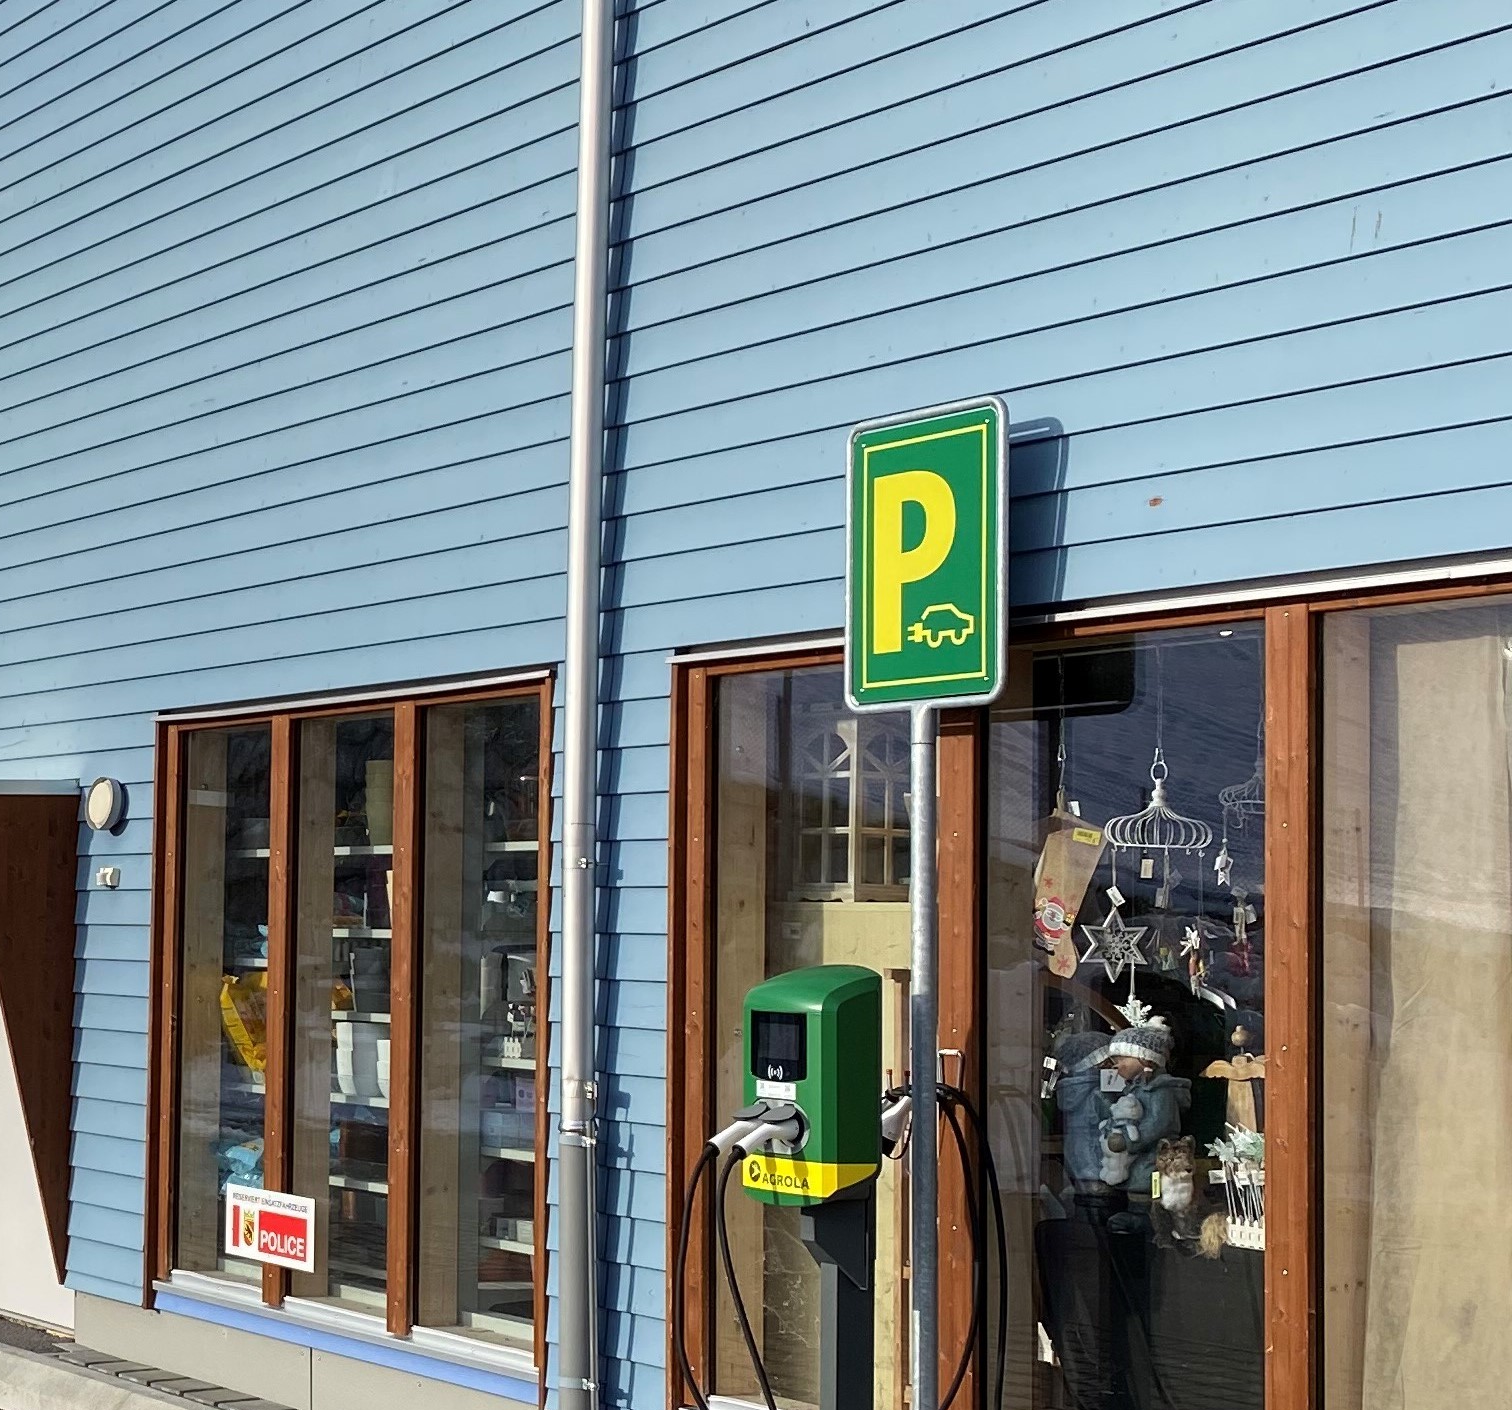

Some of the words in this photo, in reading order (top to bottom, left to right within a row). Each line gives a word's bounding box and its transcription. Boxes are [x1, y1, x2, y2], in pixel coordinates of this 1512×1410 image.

[873, 470, 956, 654] P
[762, 1173, 810, 1190] AGROLA
[260, 1230, 305, 1258] POLICE
